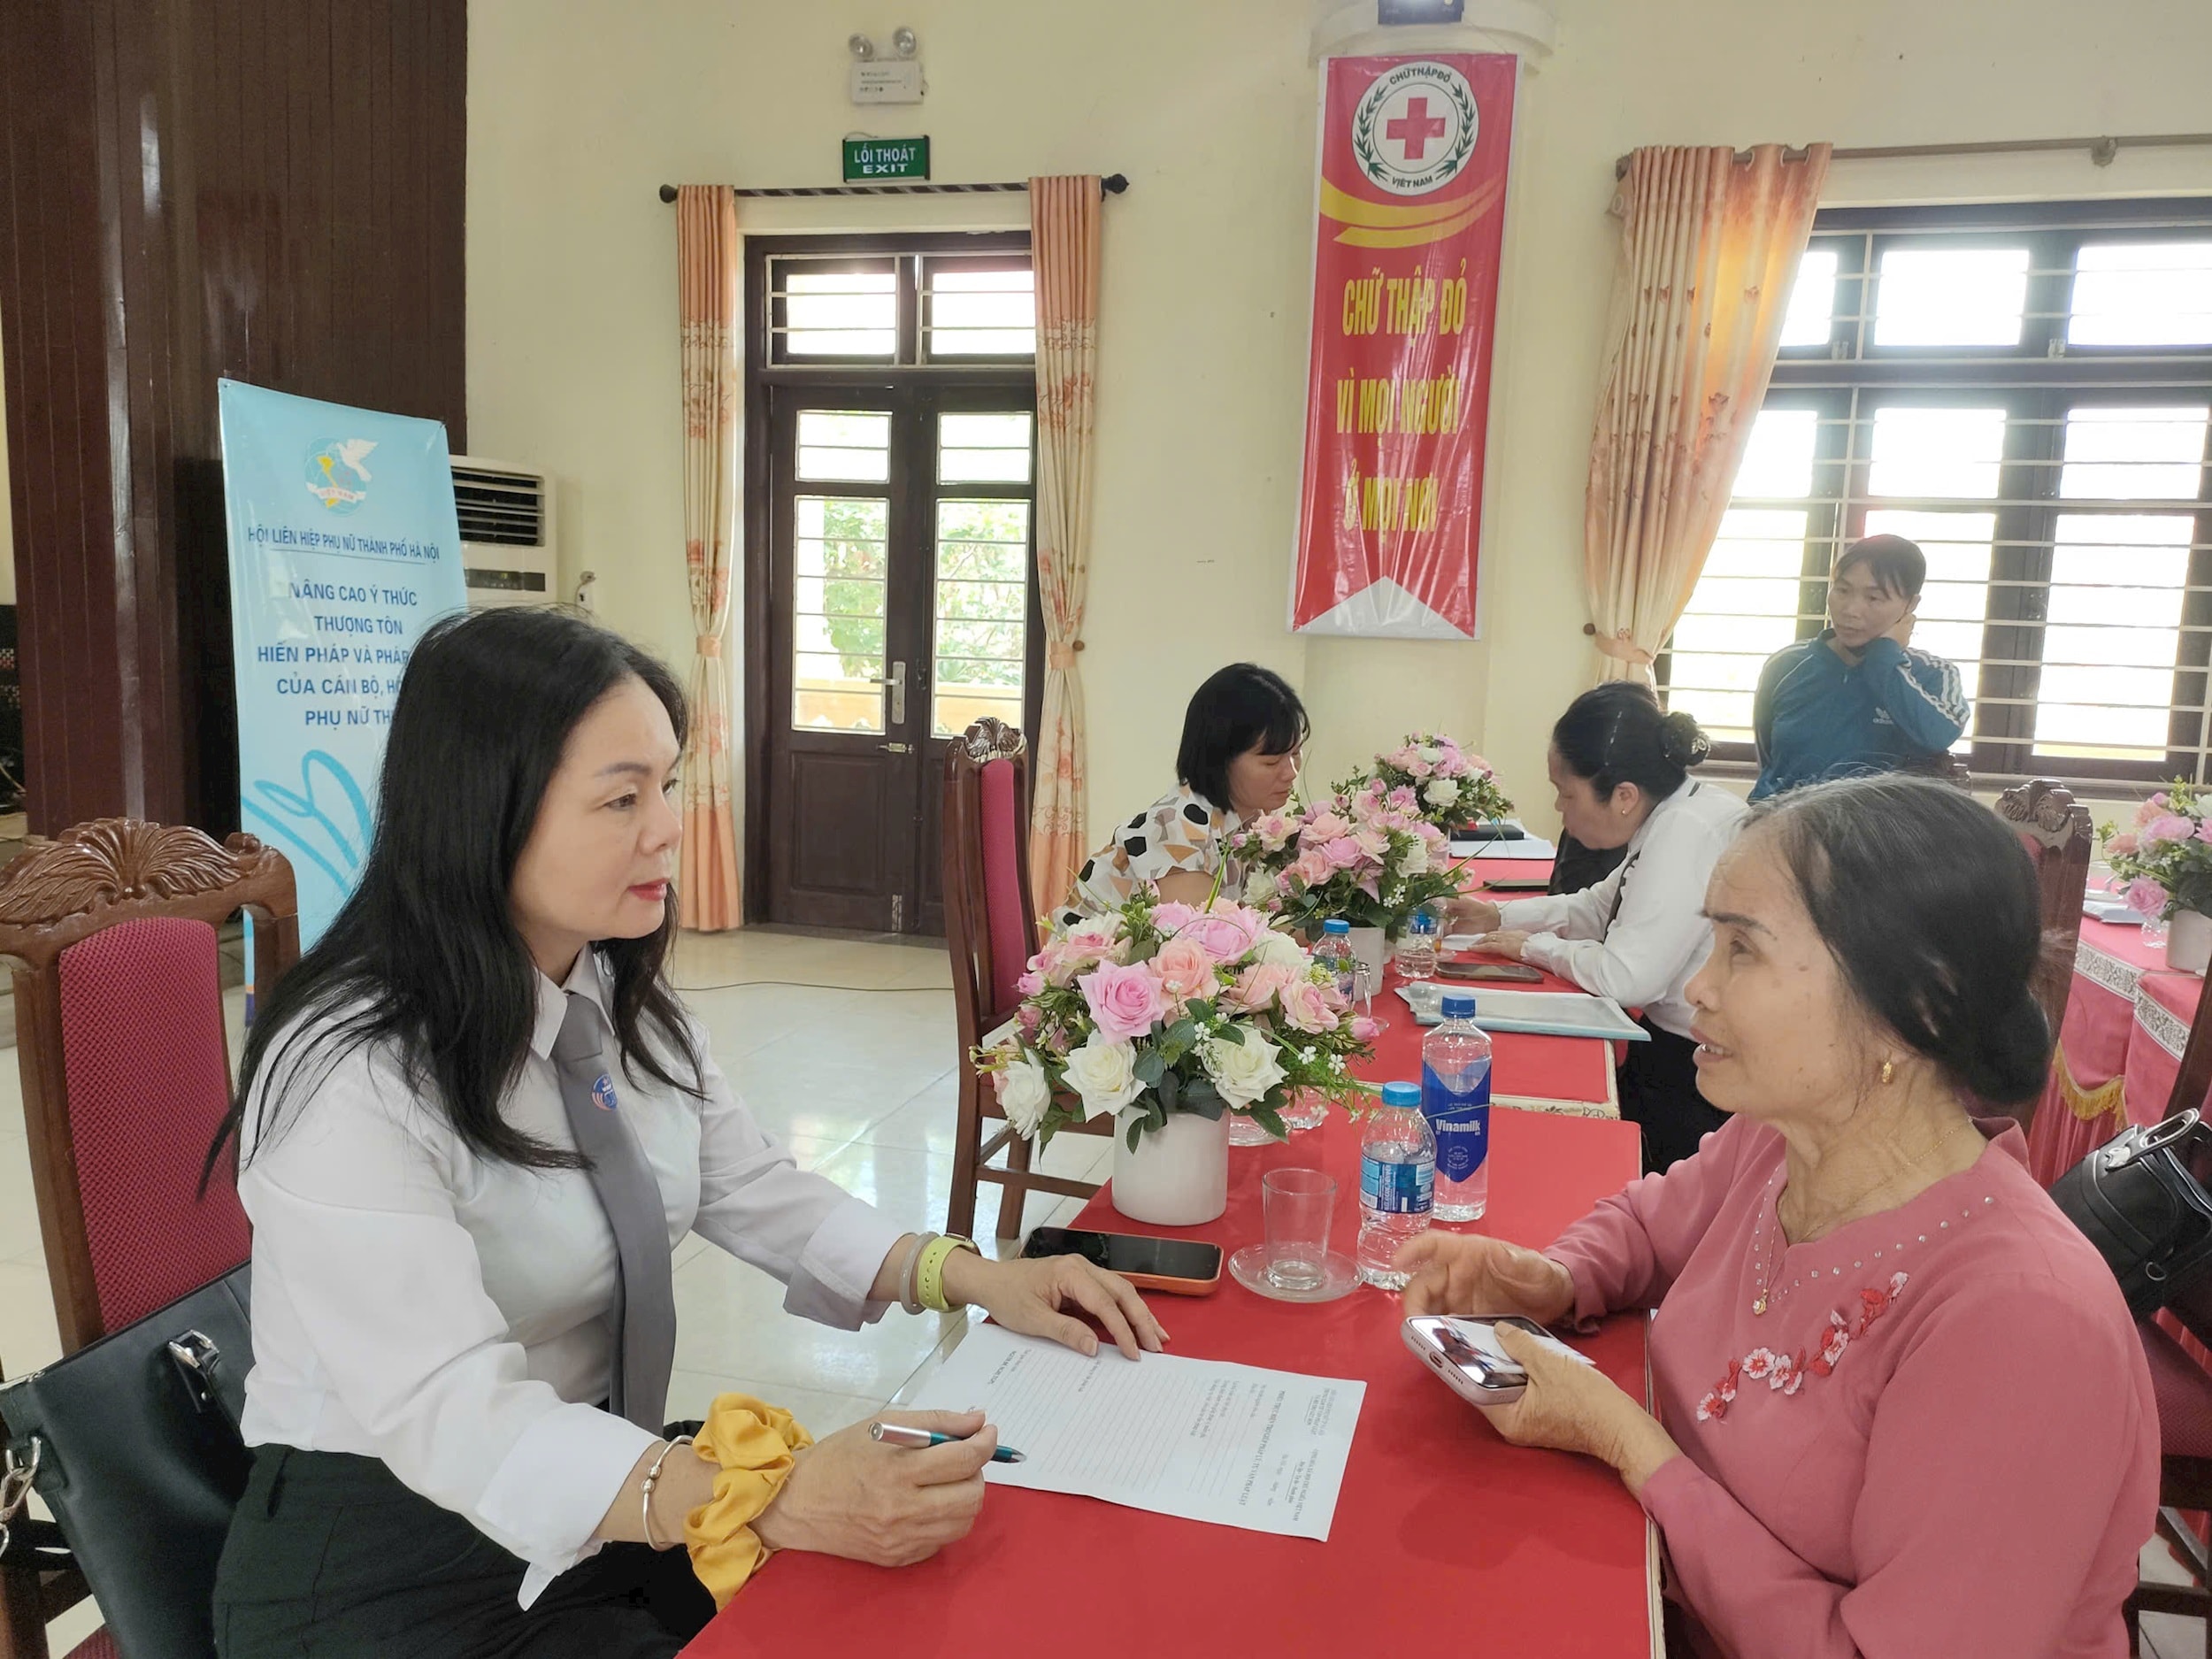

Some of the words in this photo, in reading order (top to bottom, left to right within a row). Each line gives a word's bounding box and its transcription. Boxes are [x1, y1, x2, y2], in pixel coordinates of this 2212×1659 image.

[854, 142, 873, 164] LỐI
[876, 144, 916, 164] THOÁT
[863, 164, 908, 174] EXIT
[1392, 176, 1412, 188] VIỆT
[1412, 175, 1433, 188] NAM
[1342, 266, 1384, 336] CHỮ
[1386, 265, 1436, 347] THẬP
[1439, 257, 1468, 335] ĐỎ
[1336, 366, 1355, 434] VÌ
[1357, 378, 1395, 447] MỌI
[1399, 364, 1460, 434] NGƯỜI
[1343, 457, 1360, 531] Ở
[1362, 476, 1400, 543] MỌI
[1403, 472, 1439, 532] NƠI
[248, 524, 269, 548] HỘI
[272, 526, 297, 545] LIÊN
[300, 528, 319, 549] HIỆP
[322, 534, 341, 553] PHỤ
[389, 537, 407, 557] PHỐ
[409, 541, 422, 558] HÀ
[423, 542, 440, 564] NỘI
[289, 579, 335, 600] NÂNG
[339, 585, 366, 603] CAO
[369, 584, 378, 603] Ý
[382, 587, 418, 606] THỨC
[314, 615, 373, 637] THƯỢNG
[376, 616, 403, 634] TÔN
[257, 640, 298, 663] HIẾN
[305, 643, 349, 663] PHÁP
[354, 644, 373, 663] VÀ
[277, 672, 316, 695] CỦA
[321, 674, 357, 695] CÁN
[361, 674, 383, 699] BỘ,
[305, 710, 342, 731] PHỤ
[347, 705, 370, 725] NỮ
[373, 709, 391, 726] TH
[1435, 1118, 1481, 1133] Vinamilk
